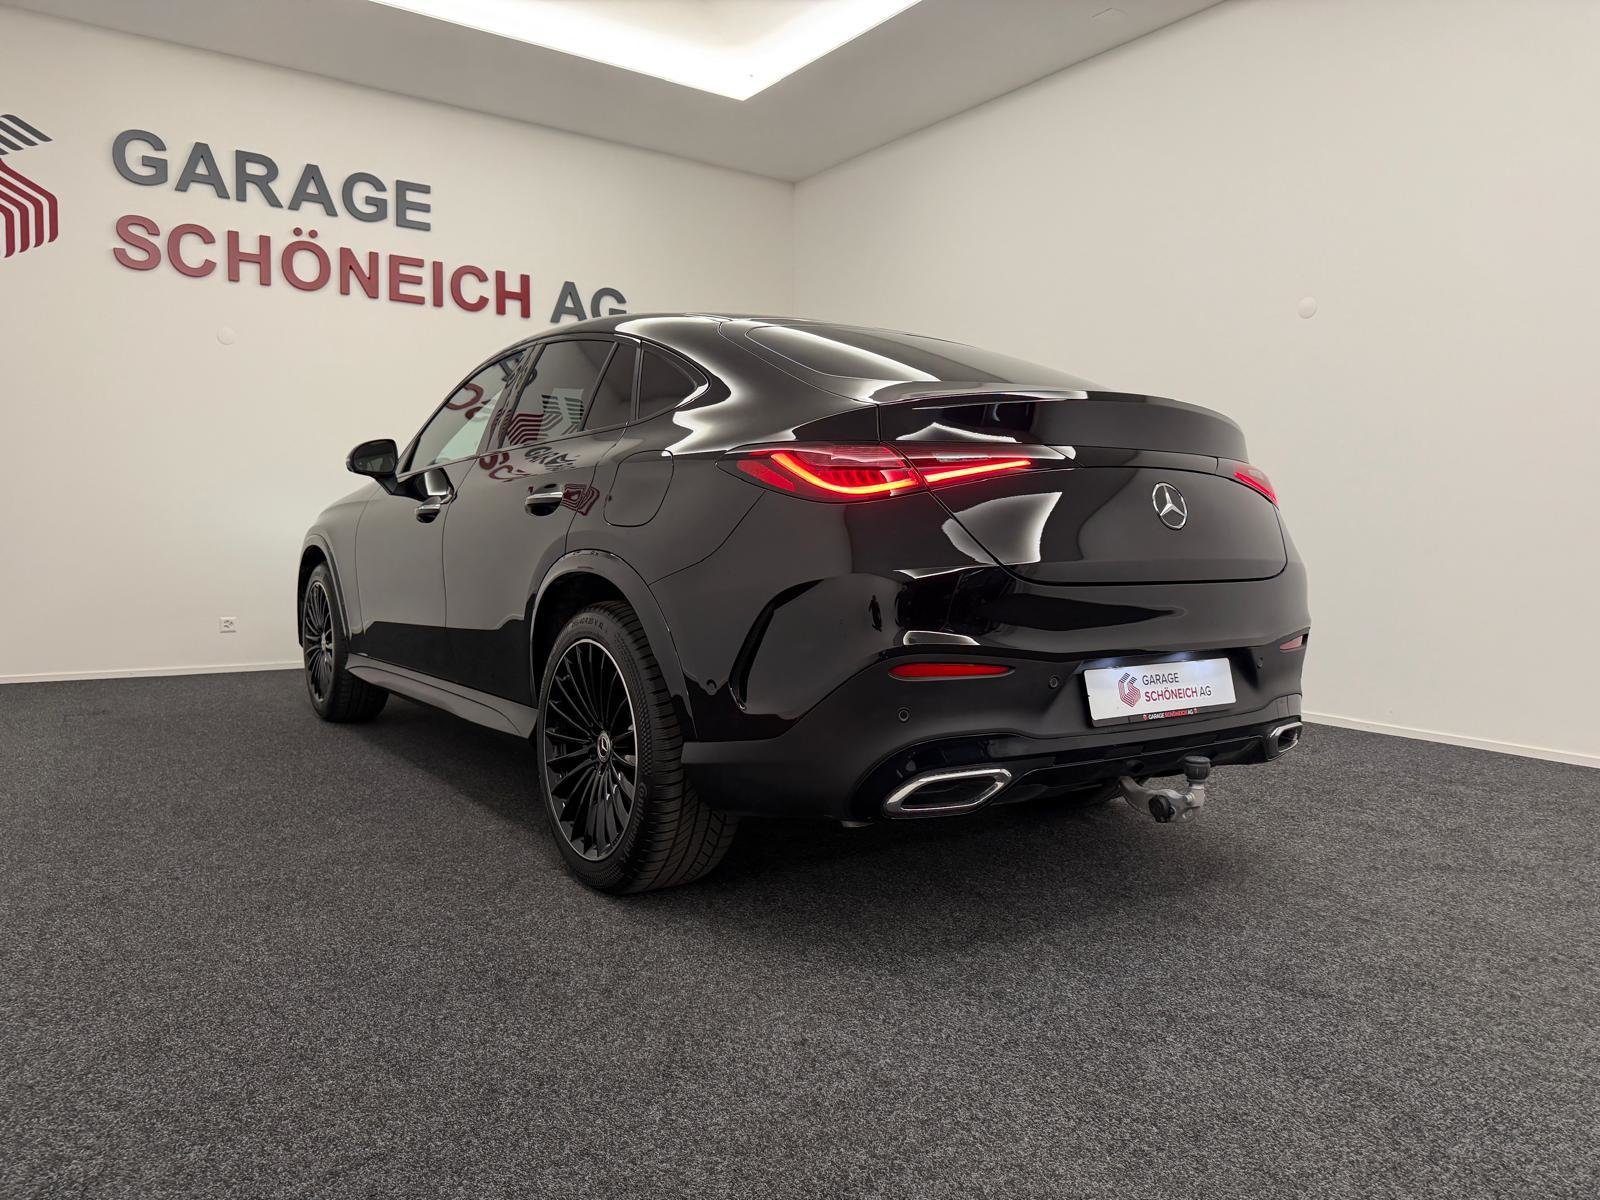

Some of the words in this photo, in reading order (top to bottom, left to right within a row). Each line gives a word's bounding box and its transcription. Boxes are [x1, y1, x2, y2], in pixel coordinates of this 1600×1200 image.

[112, 129, 431, 231] GARAGE
[113, 215, 531, 318] SCHÖNEICH
[550, 281, 627, 323] AG
[1142, 673, 1179, 685] GARAGE
[1145, 687, 1198, 702] SCHÖNEICH
[1199, 685, 1212, 697] AG
[1148, 712, 1165, 720] GARAGE
